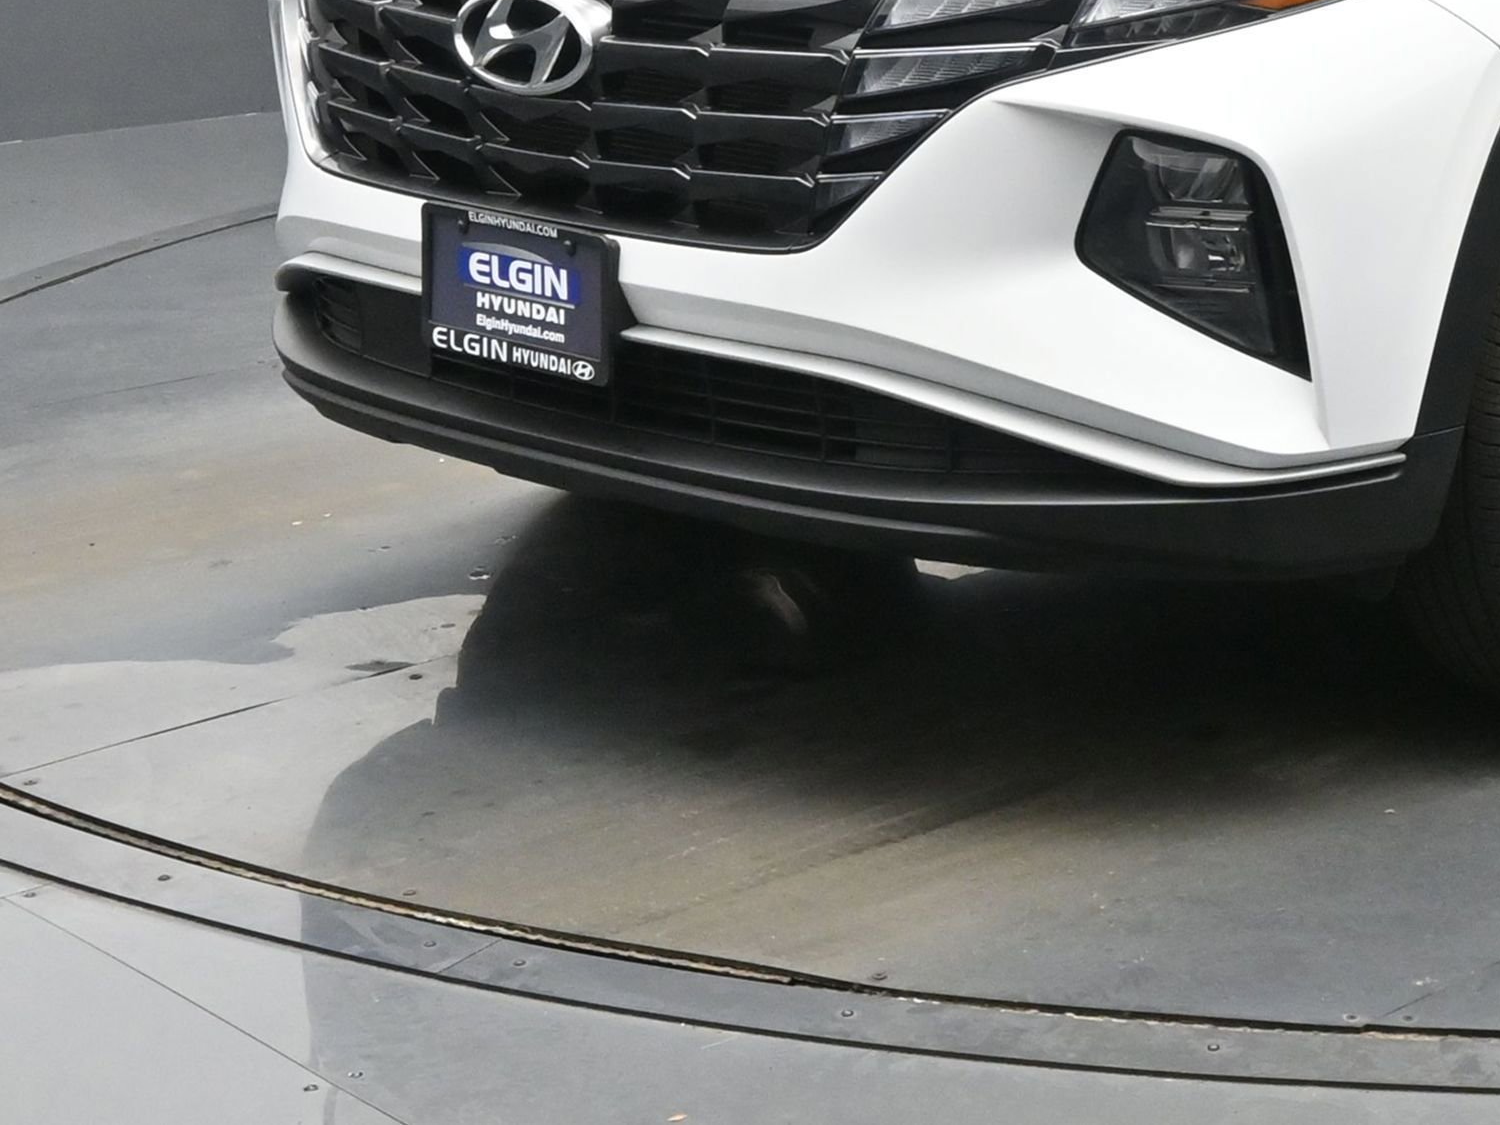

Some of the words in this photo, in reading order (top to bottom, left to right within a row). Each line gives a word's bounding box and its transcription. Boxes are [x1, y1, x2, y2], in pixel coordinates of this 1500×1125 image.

[468, 210, 557, 238] ELGINHYUNDAI.COM
[468, 251, 568, 300] ELGIN
[476, 291, 565, 325] HYUNDAI
[476, 313, 565, 344] ElginHyundai.com
[432, 326, 508, 363] ELGIN
[512, 346, 571, 375] HYUNDAI
